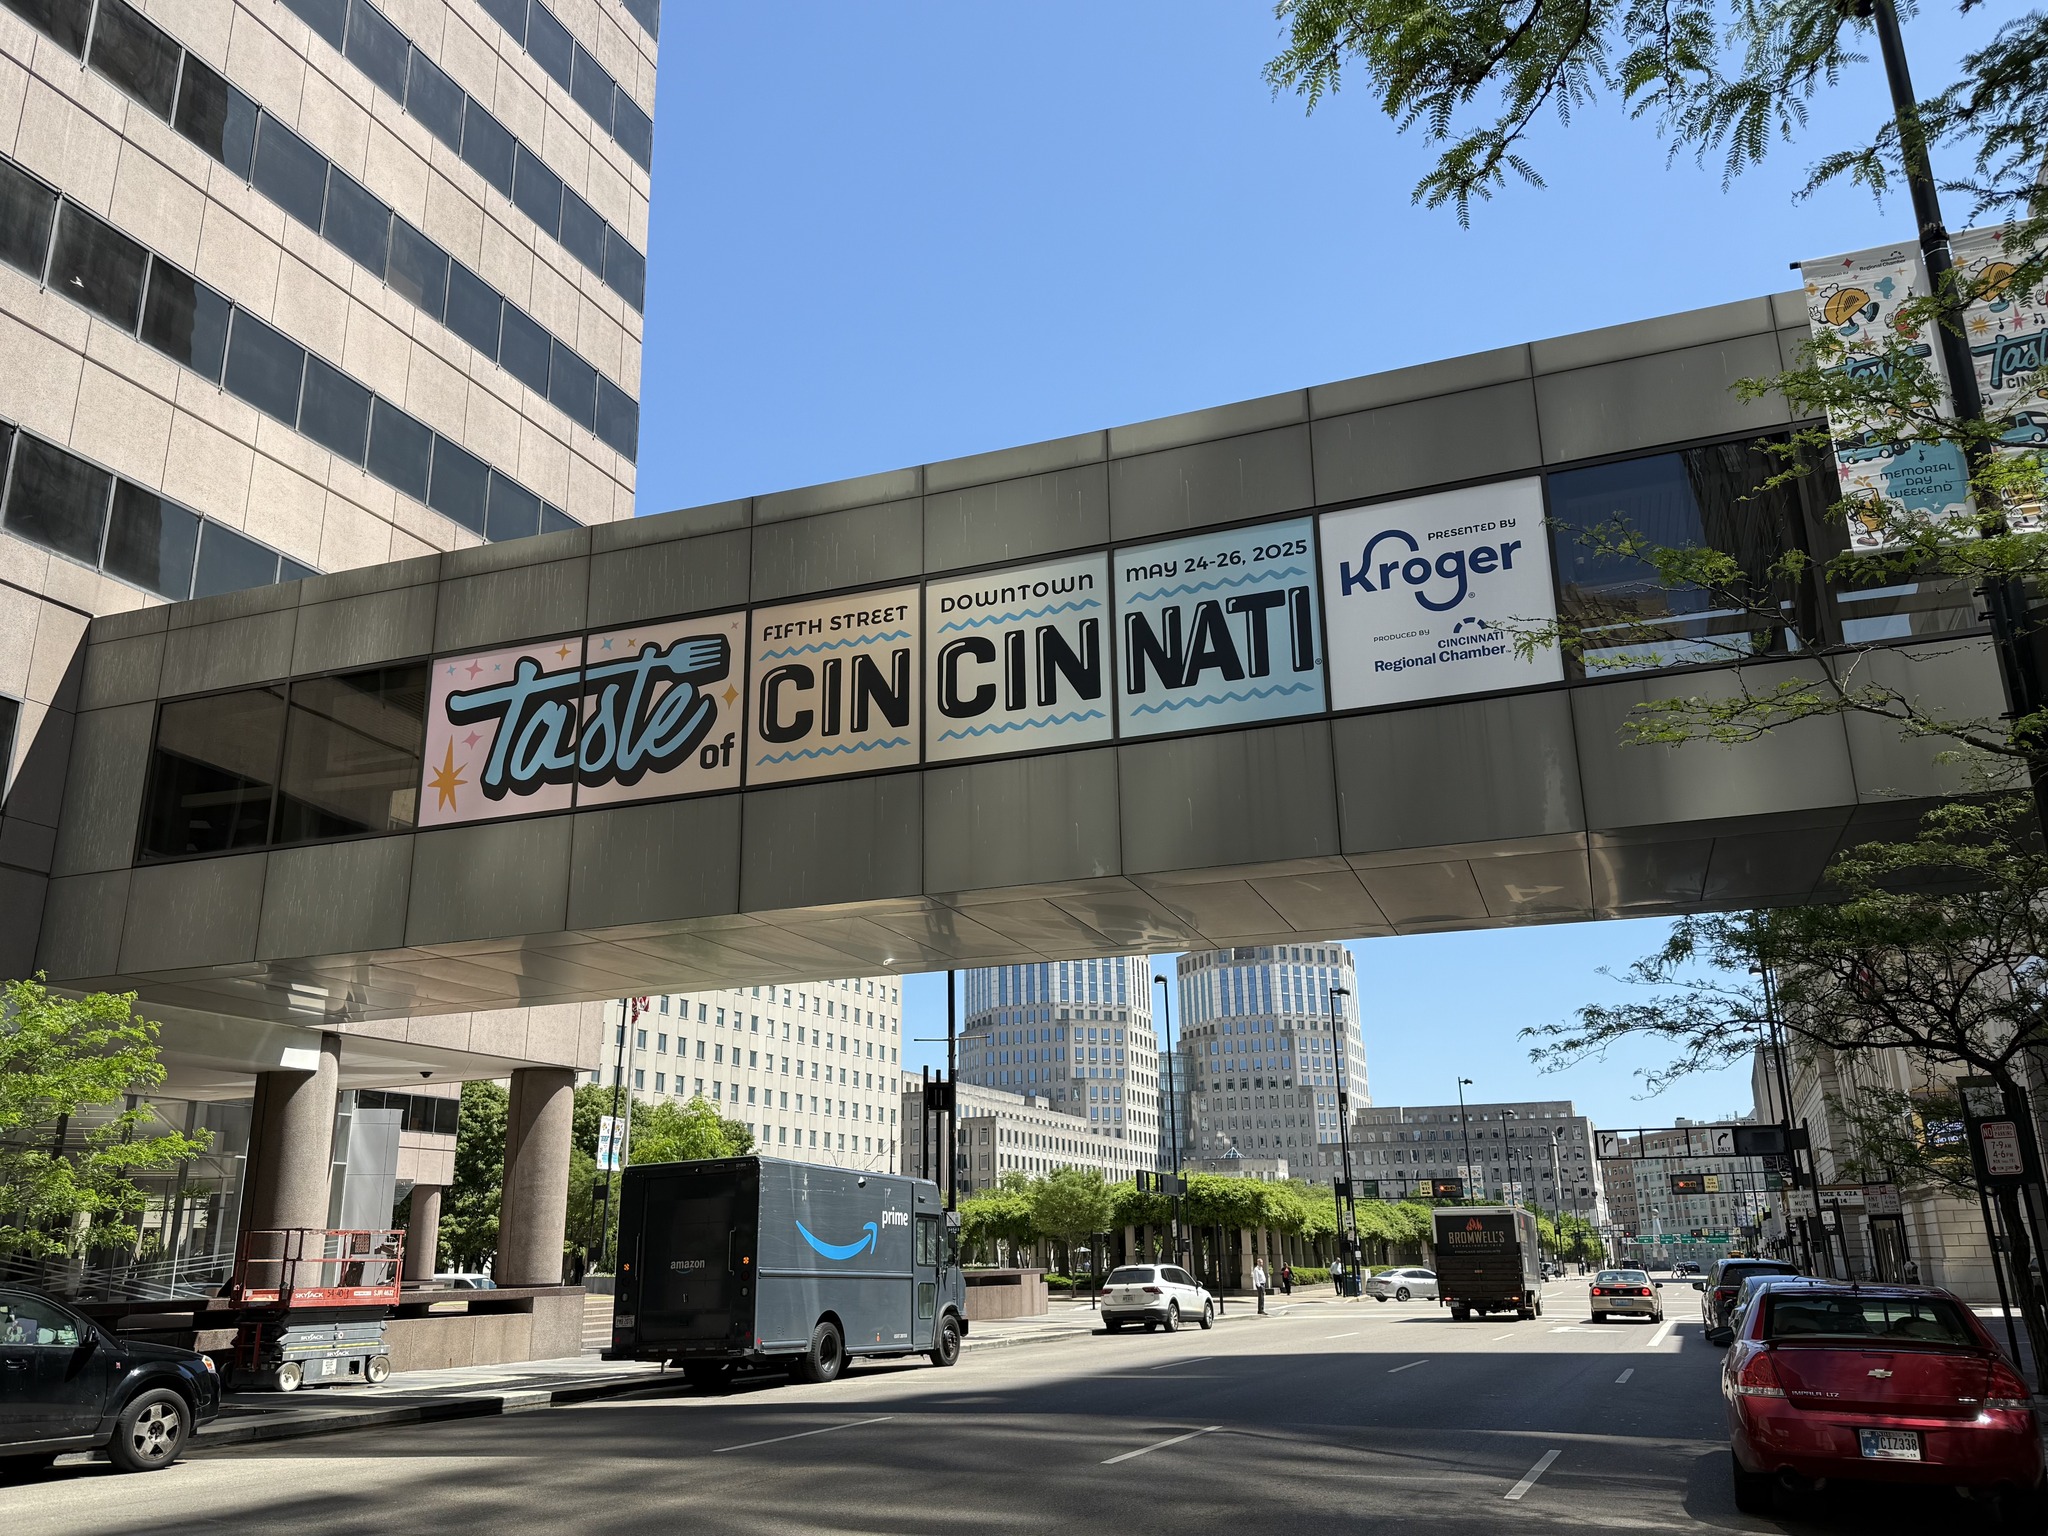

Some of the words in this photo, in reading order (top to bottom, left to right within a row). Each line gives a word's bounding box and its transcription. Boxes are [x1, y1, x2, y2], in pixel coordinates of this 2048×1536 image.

[1880, 463, 1955, 480] MEMORIAL
[1905, 476, 1932, 486] DAY
[1889, 484, 1953, 498] WEEKEND
[1427, 522, 1496, 541] PRESENTED
[1499, 518, 1517, 529] BY
[1183, 550, 1247, 575] 24-26,
[1252, 539, 1308, 563] 2025
[1339, 529, 1522, 612] Kroger
[940, 574, 1094, 614] DOWNTOWN
[763, 616, 823, 641] FIFTH
[829, 605, 909, 632] STREET
[1373, 631, 1417, 643] PRODUCED
[1418, 629, 1430, 638] BY
[1437, 631, 1504, 649] CINCINNATI
[1374, 653, 1437, 672] Regional
[1439, 644, 1506, 663] Chamber
[699, 732, 736, 770] of
[1982, 1127, 1993, 1138] NO
[882, 1207, 909, 1229] prime
[1448, 1231, 1505, 1244] BROMWELL'S
[670, 1258, 705, 1269] amazon
[295, 1290, 324, 1299] SKYJACK
[300, 1333, 324, 1341] SKYJACK
[1880, 1436, 1918, 1451] CIZ338
